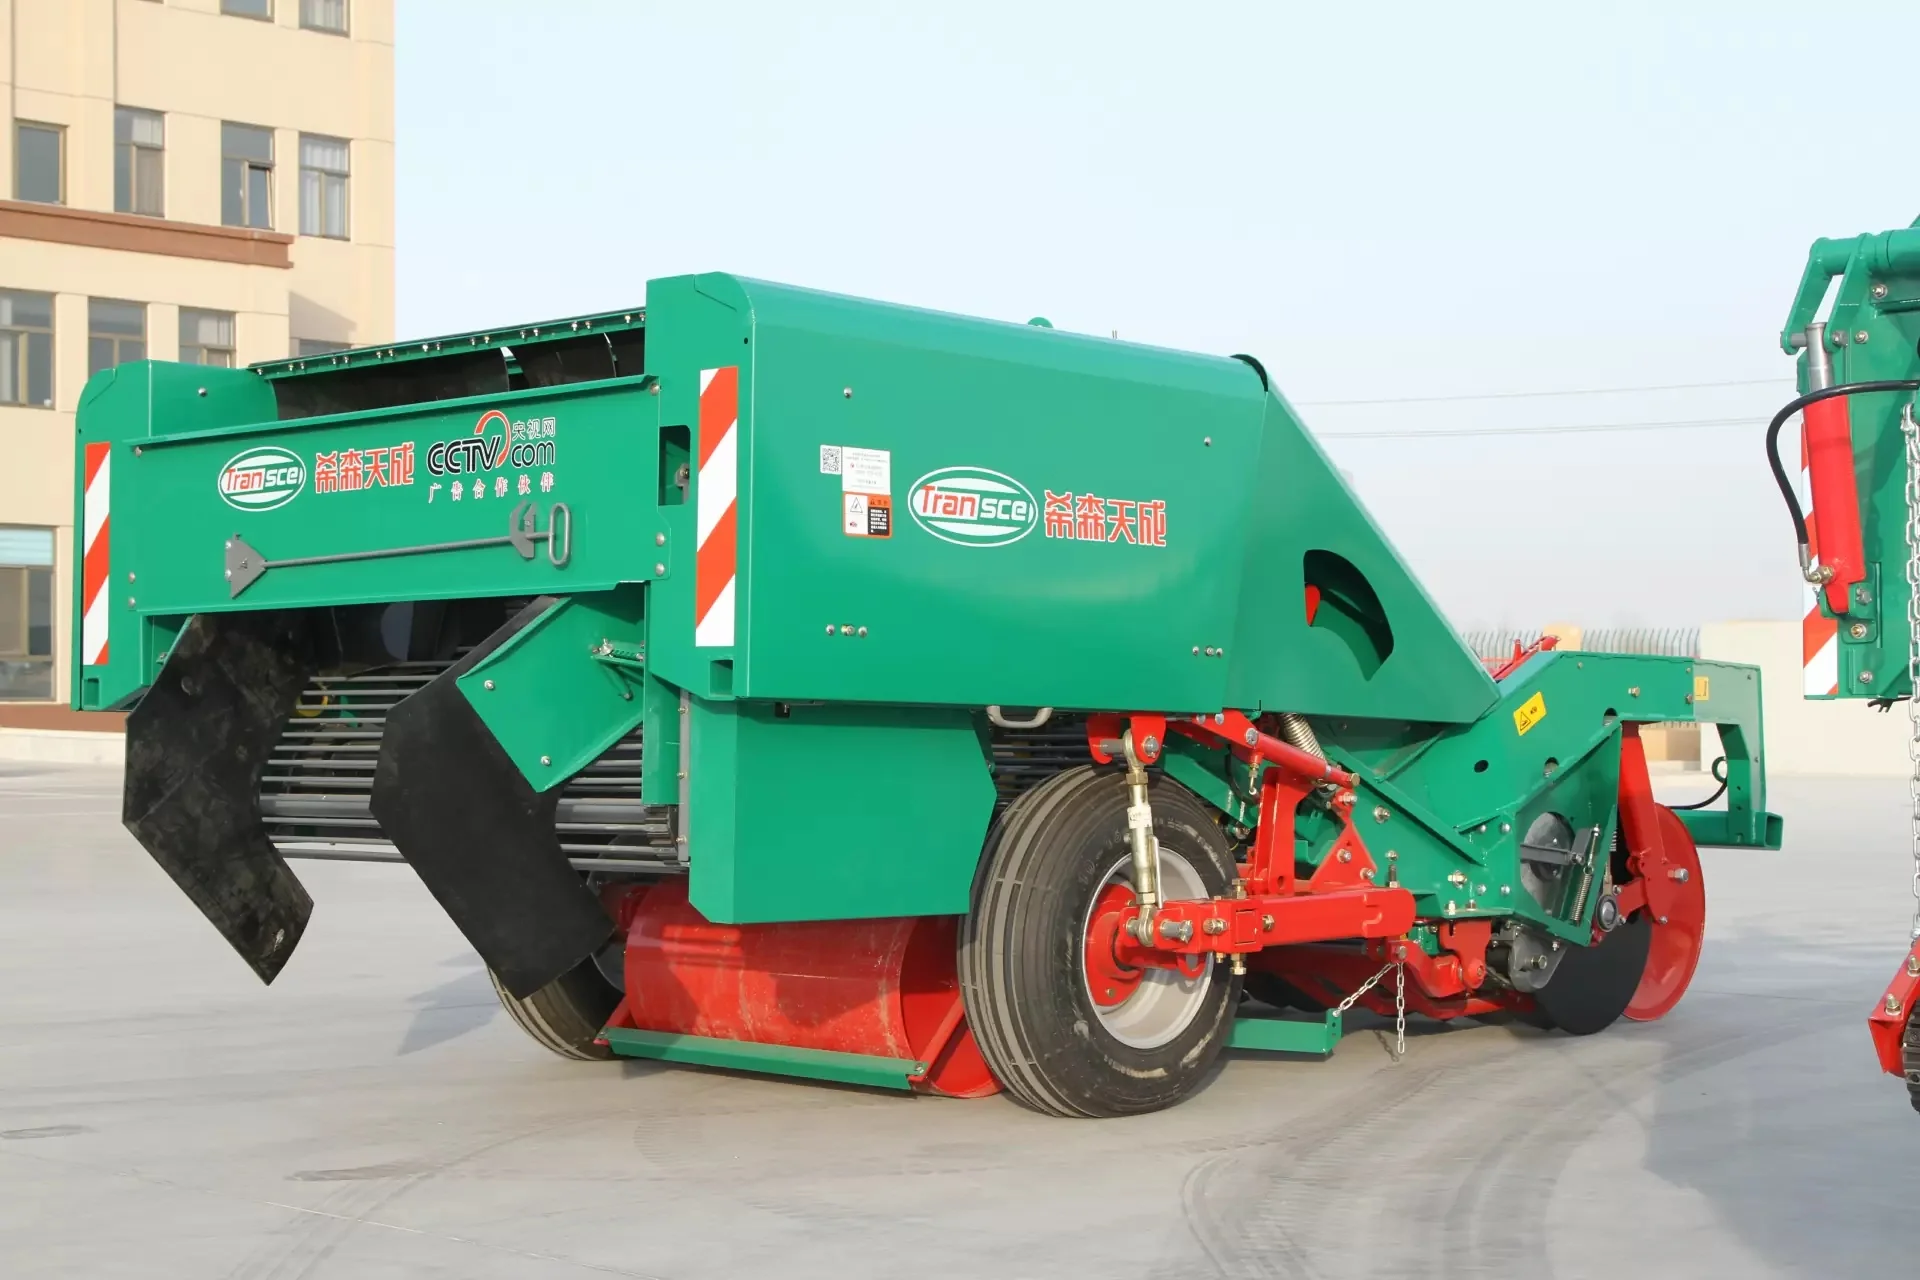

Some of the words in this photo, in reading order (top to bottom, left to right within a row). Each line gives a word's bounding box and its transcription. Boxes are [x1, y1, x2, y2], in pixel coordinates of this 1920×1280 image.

[512, 417, 556, 441] 央视网
[315, 441, 415, 494] 希森天成
[426, 434, 502, 477] CCTV
[510, 440, 556, 469] com
[427, 471, 555, 504] 广告合作伙伴
[1044, 489, 1167, 547] 希森天成
